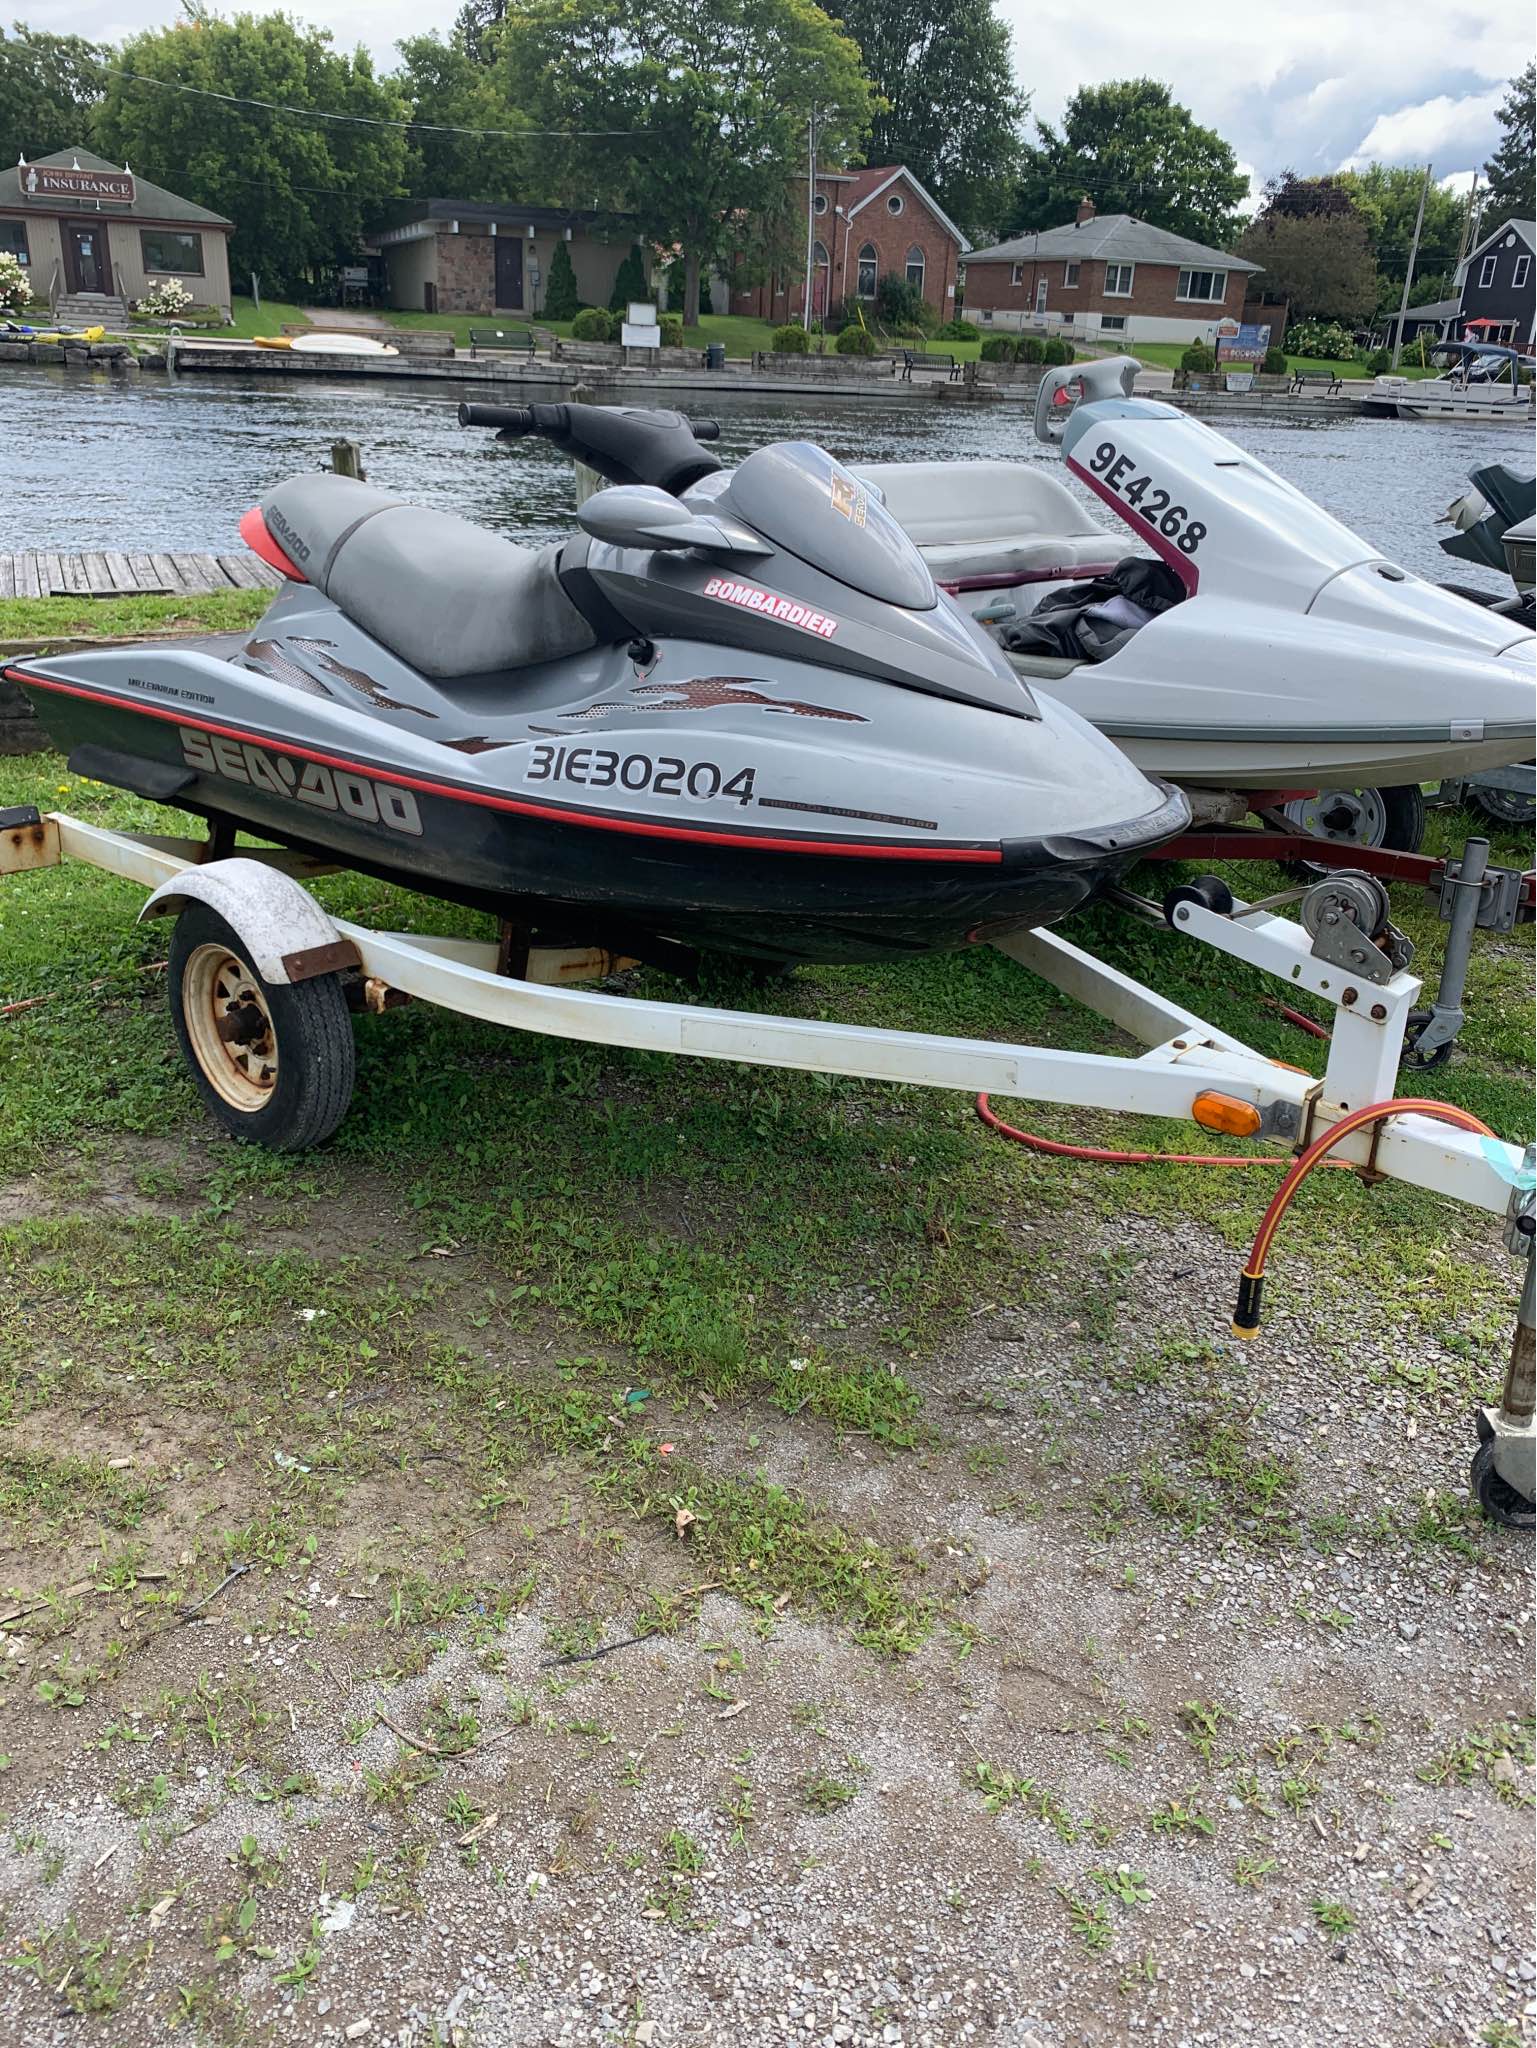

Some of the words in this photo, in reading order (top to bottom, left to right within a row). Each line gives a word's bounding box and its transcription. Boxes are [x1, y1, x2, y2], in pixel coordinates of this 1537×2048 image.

[43, 177, 130, 193] INSURANCE
[1089, 442, 1207, 554] 9E4268
[704, 577, 837, 638] BOMBARDIER
[128, 678, 179, 697] MILLENNIUM
[180, 690, 215, 704] EDITION
[527, 745, 757, 806] 31E30204
